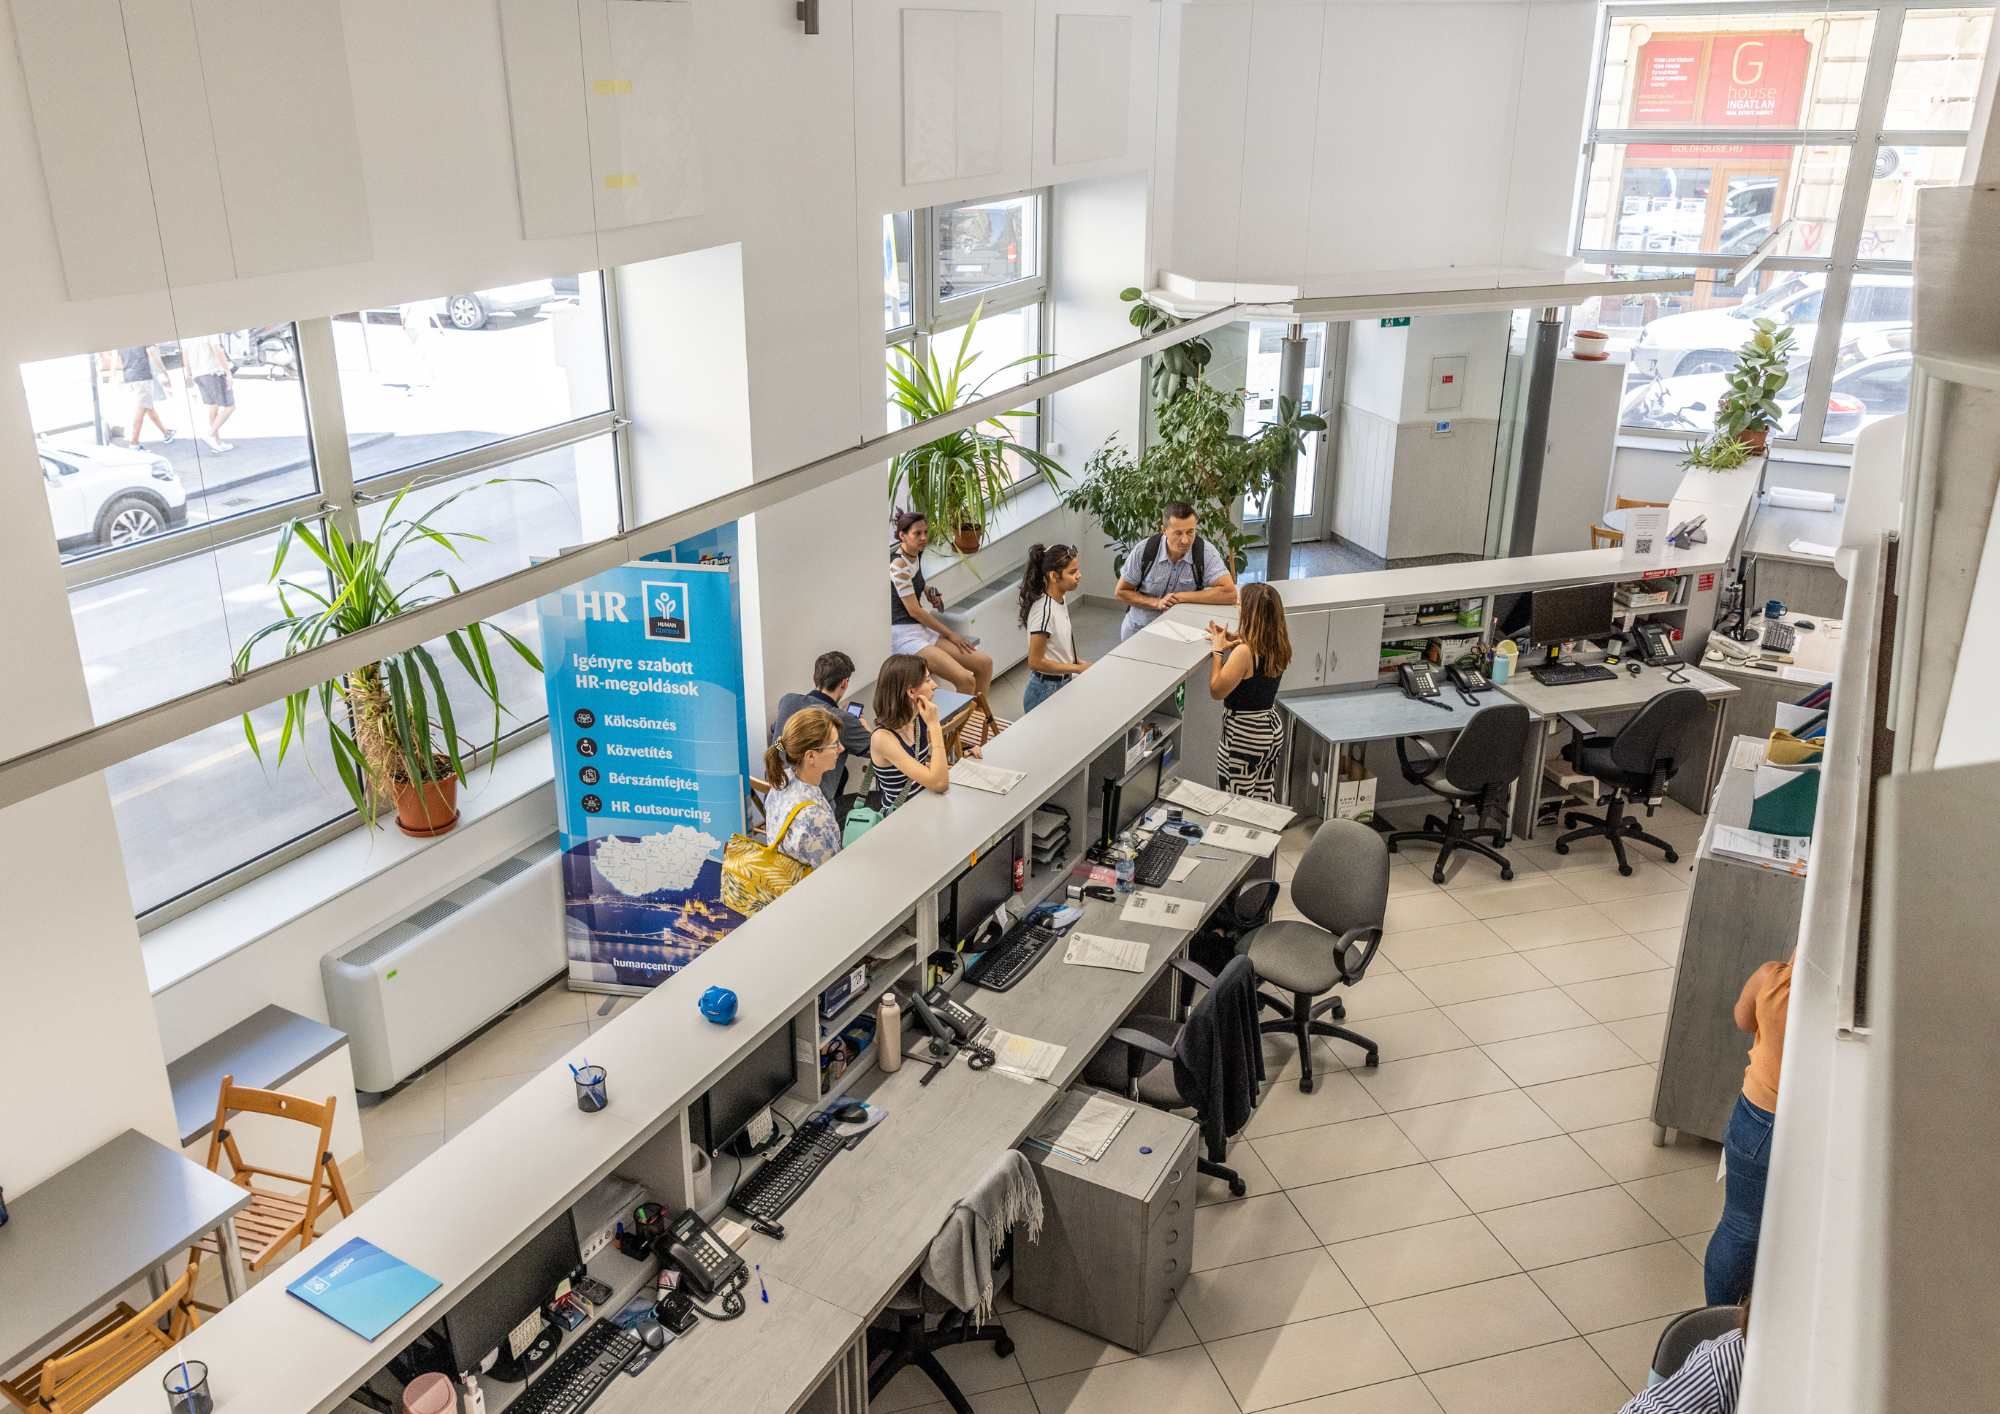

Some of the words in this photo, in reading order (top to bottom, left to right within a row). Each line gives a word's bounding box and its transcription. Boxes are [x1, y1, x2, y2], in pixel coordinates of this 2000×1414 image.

[1732, 41, 1764, 84] G
[1728, 86, 1776, 99] house
[1728, 99, 1775, 109] INGATLAN
[576, 591, 629, 623] HR
[573, 653, 633, 673] Igényre
[637, 657, 694, 675] szabott
[575, 674, 700, 696] HR-megoldások
[604, 714, 677, 731] Kölcsönzés
[606, 743, 673, 760] Közvetítés
[608, 772, 700, 792] Bérszámfejtés
[611, 801, 631, 813] HR
[634, 806, 712, 823] outsourcing
